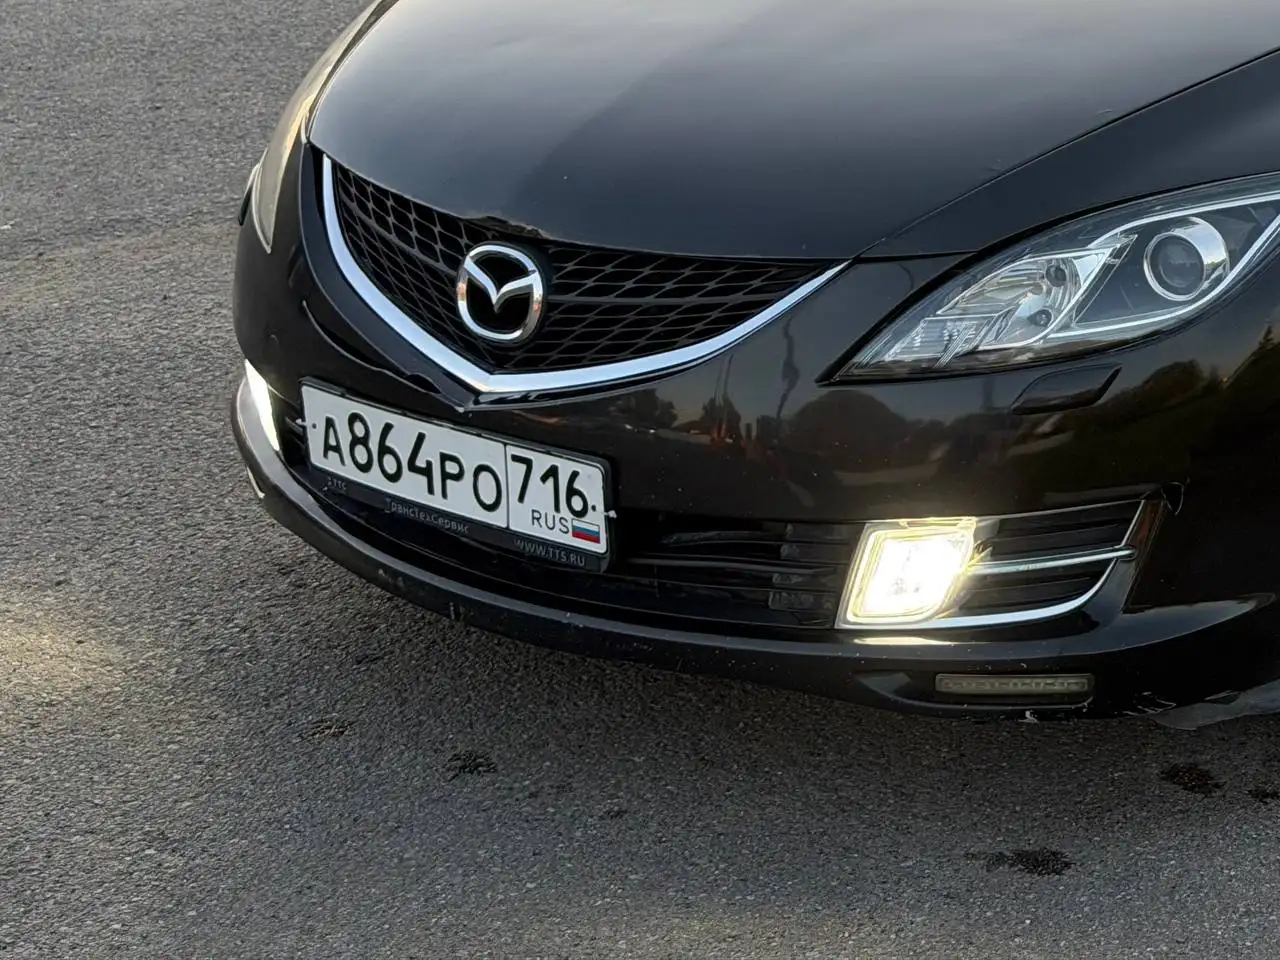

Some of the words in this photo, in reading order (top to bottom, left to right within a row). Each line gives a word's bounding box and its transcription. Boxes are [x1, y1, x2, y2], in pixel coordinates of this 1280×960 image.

[323, 412, 502, 513] А864РО
[511, 453, 589, 518] 716
[531, 509, 570, 534] RUS
